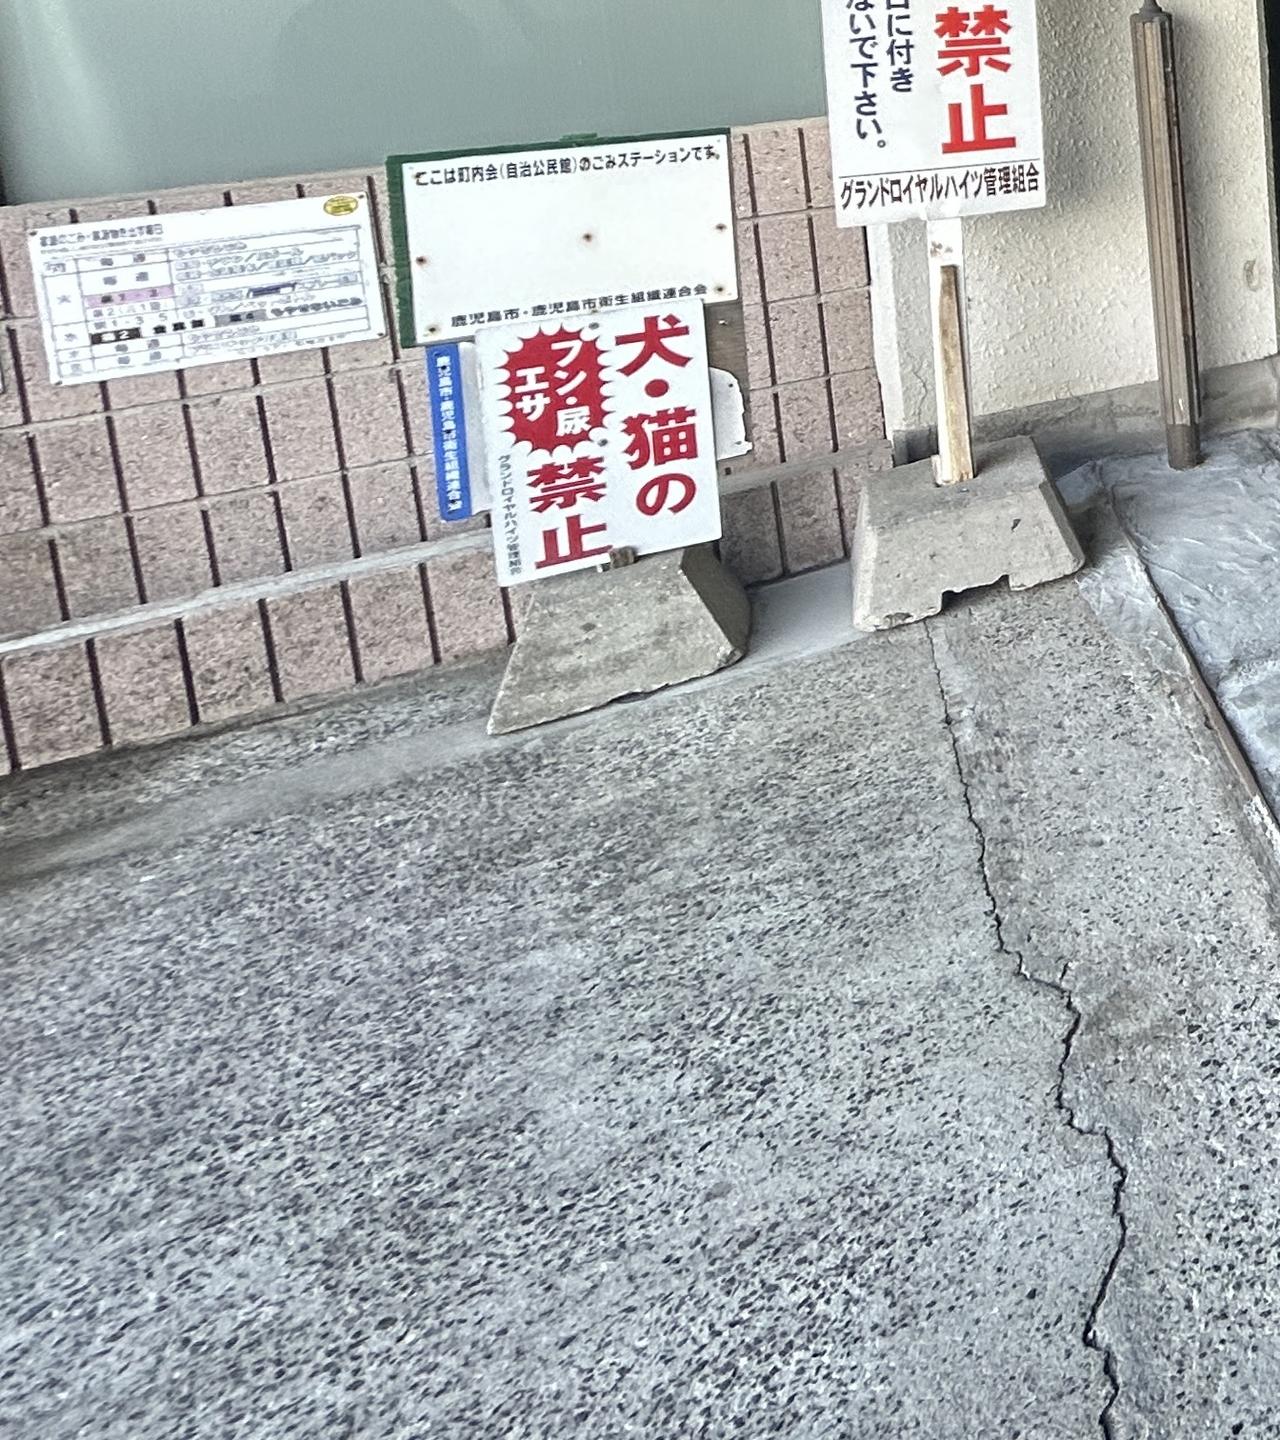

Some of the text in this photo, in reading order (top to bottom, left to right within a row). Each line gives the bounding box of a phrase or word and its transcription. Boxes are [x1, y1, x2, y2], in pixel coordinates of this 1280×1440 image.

[840, 161, 1041, 211] グランドロイヤルハイツ管理組合
[515, 366, 550, 422] エサ
[550, 339, 592, 437] フン・尿
[614, 313, 699, 517] 犬・猫の
[526, 455, 613, 570] 禁止
